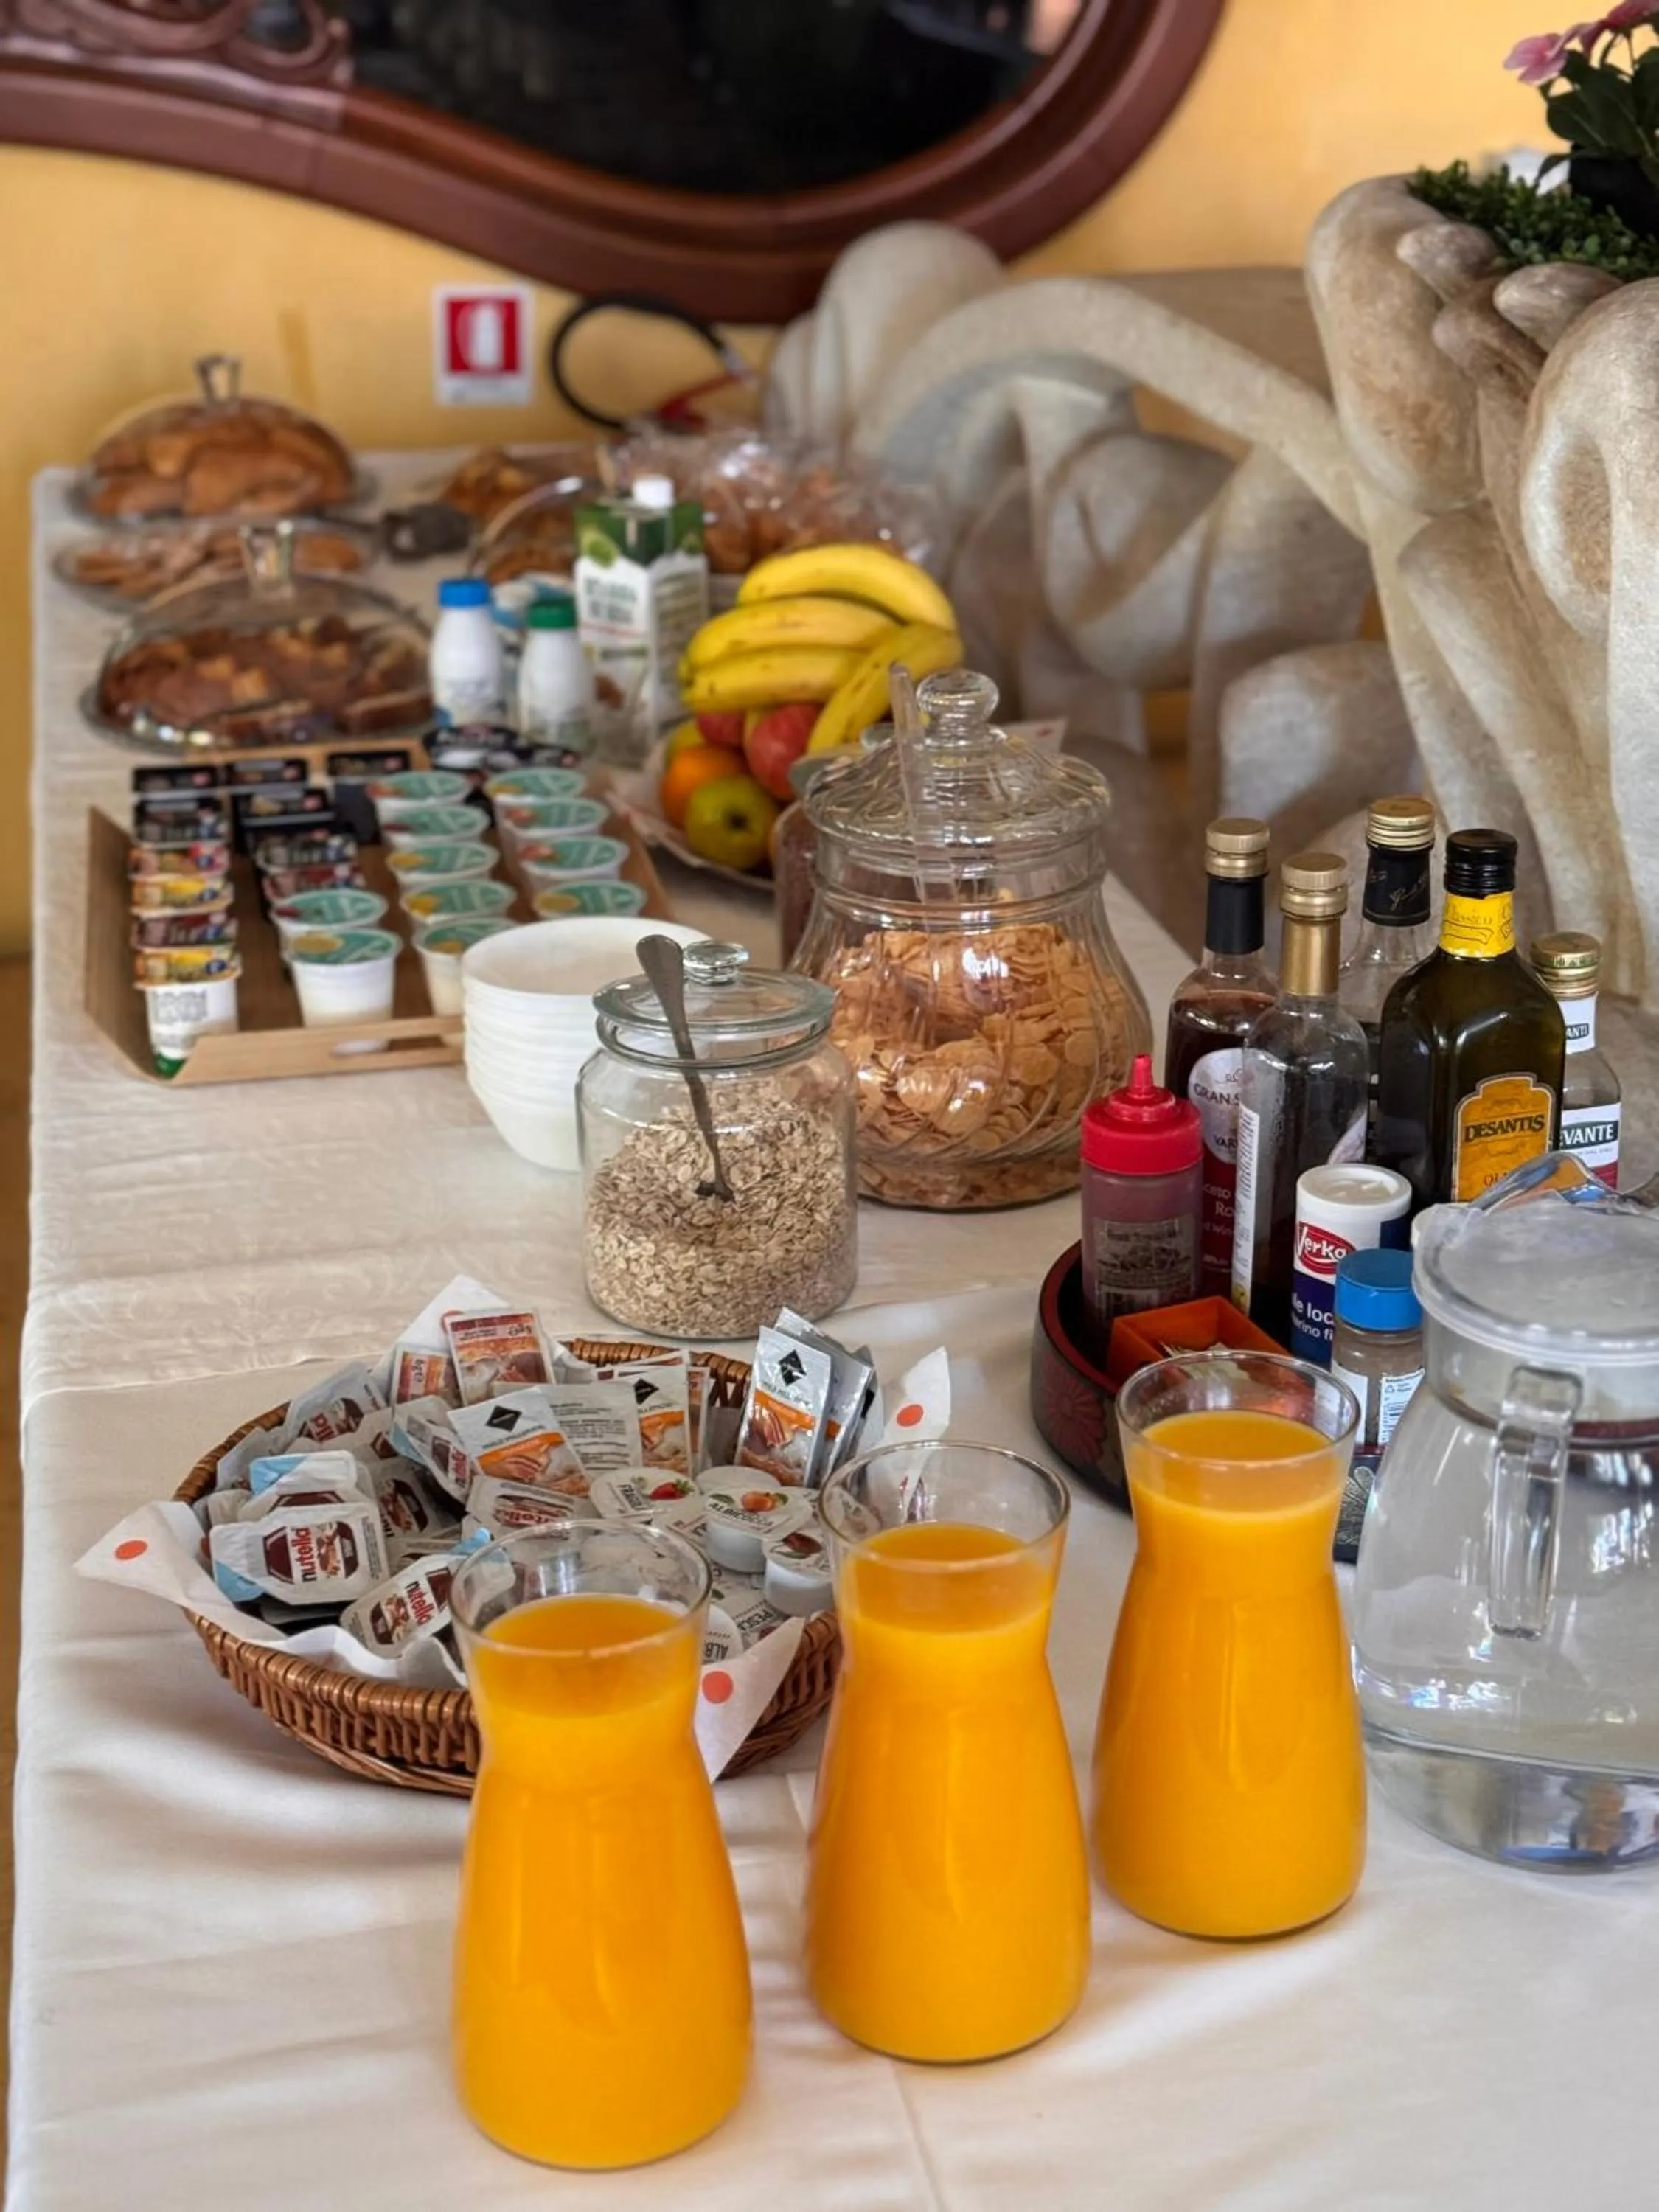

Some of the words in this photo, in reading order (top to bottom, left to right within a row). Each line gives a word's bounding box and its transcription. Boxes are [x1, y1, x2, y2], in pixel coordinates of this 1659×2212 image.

[1194, 1083, 1230, 1105] GRAN
[1464, 1114, 1545, 1142] DESANTIS
[1560, 1122, 1614, 1146] VANTE
[1215, 1201, 1235, 1217] Ro
[291, 1527, 316, 1582] nutella
[405, 1580, 434, 1626] nutella
[705, 1641, 729, 1660] ALB
